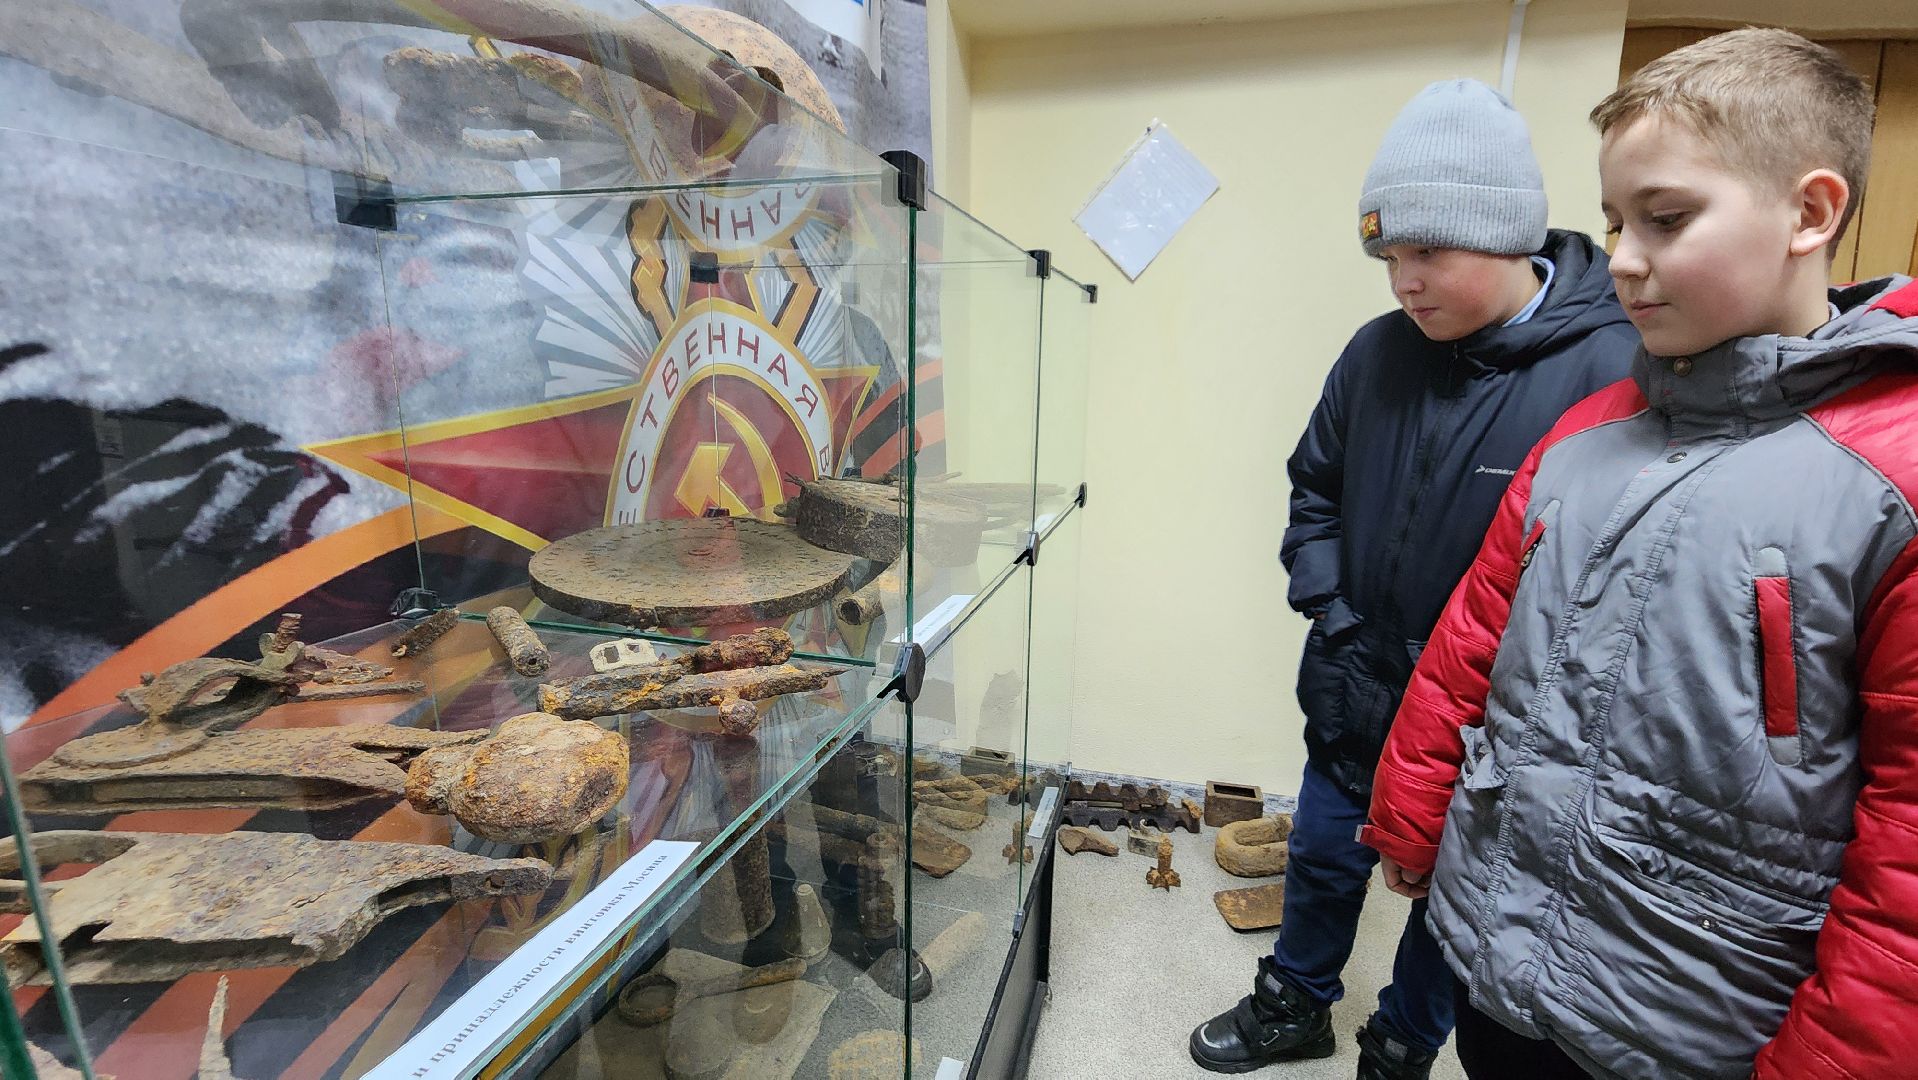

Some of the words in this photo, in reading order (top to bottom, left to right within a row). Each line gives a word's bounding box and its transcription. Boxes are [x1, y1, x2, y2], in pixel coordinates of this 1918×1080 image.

[429, 946, 567, 1063] принадлежности
[563, 893, 627, 945] винтовки
[620, 854, 668, 892] Мосина
